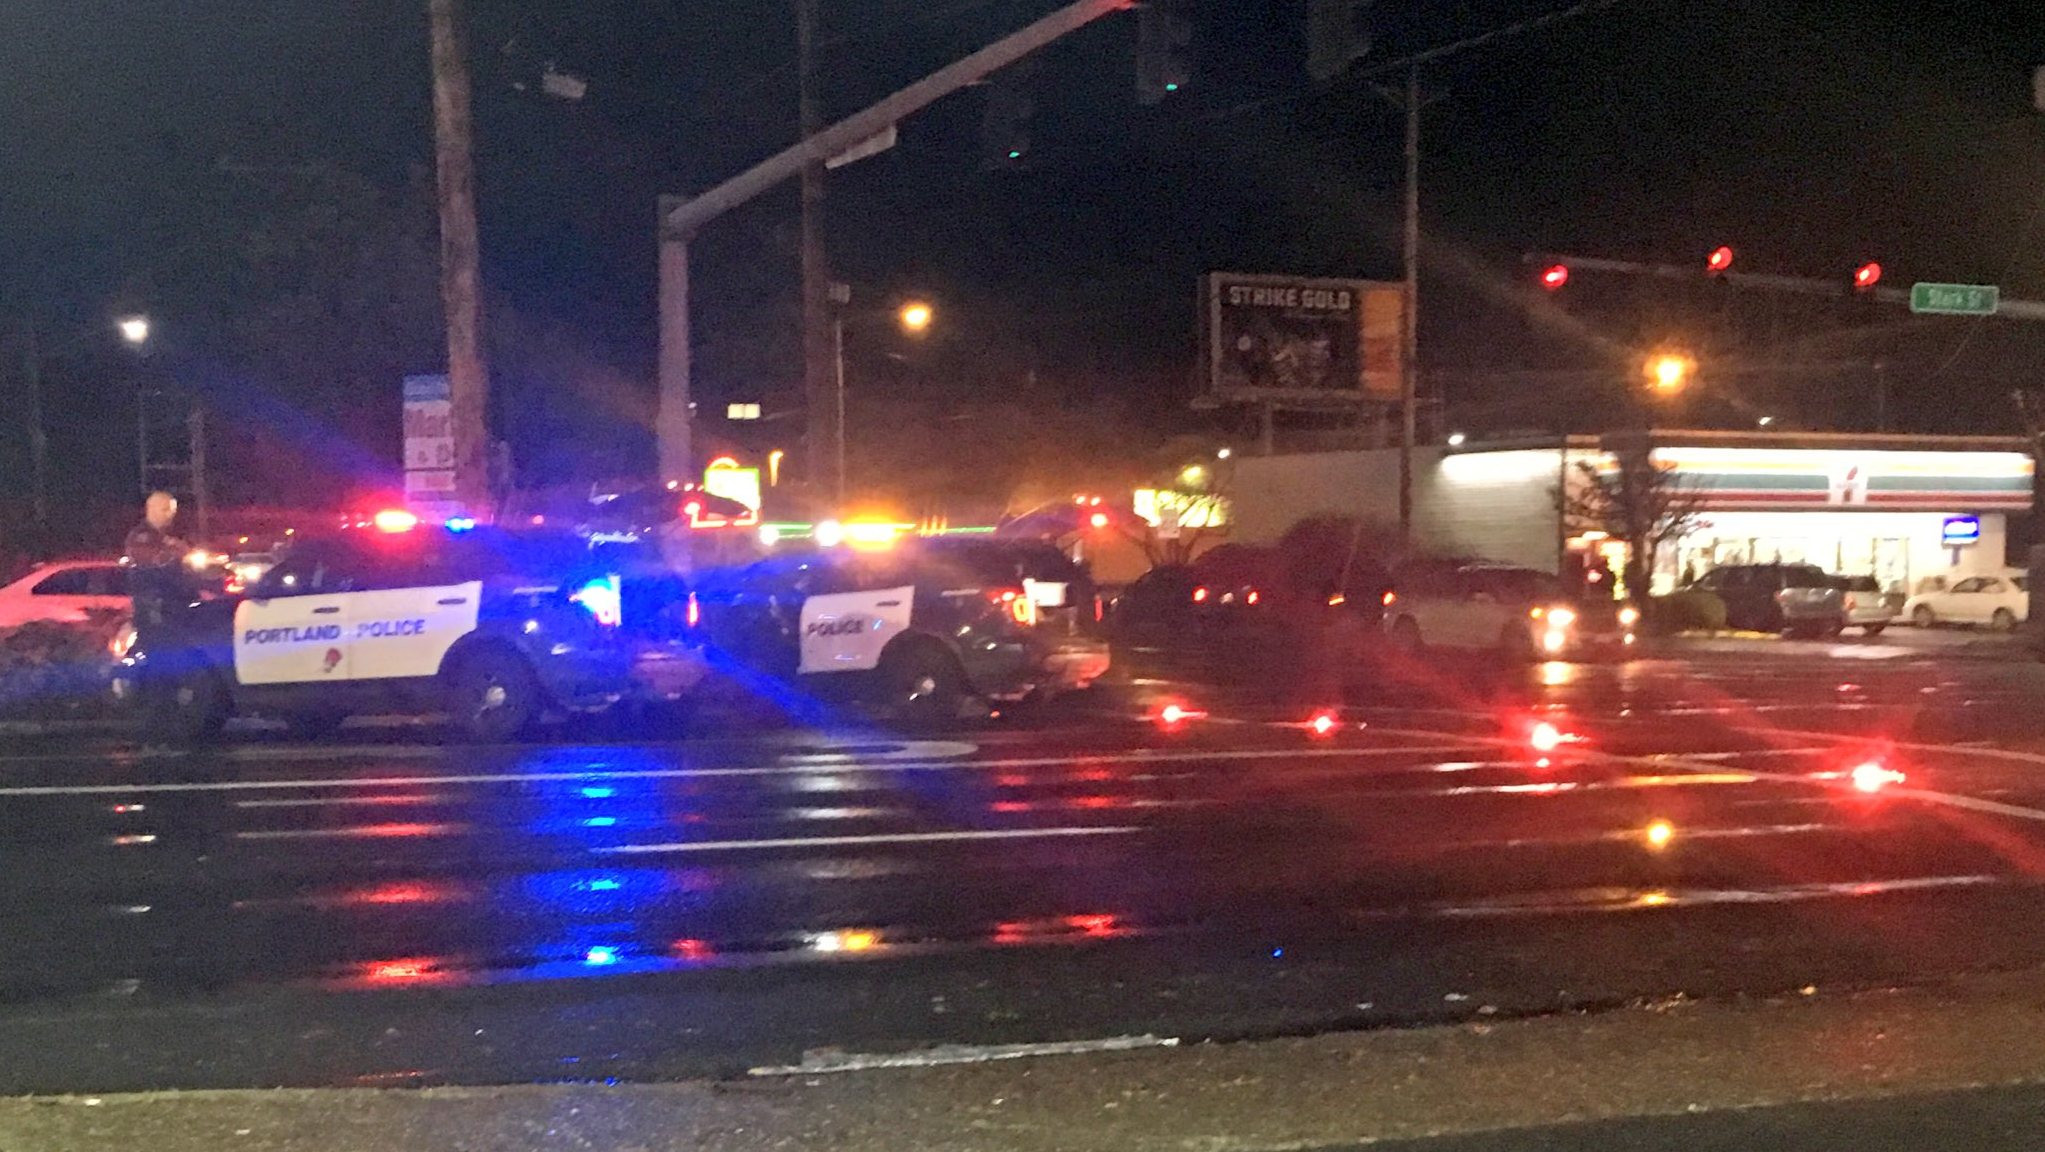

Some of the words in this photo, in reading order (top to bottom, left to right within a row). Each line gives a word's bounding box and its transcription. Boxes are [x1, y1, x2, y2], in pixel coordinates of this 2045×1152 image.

[1229, 285, 1299, 308] STRIKE
[1301, 290, 1352, 310] GOLD
[244, 624, 342, 645] PORTLAND
[356, 618, 426, 639] POLICE
[807, 619, 865, 638] POLICE
